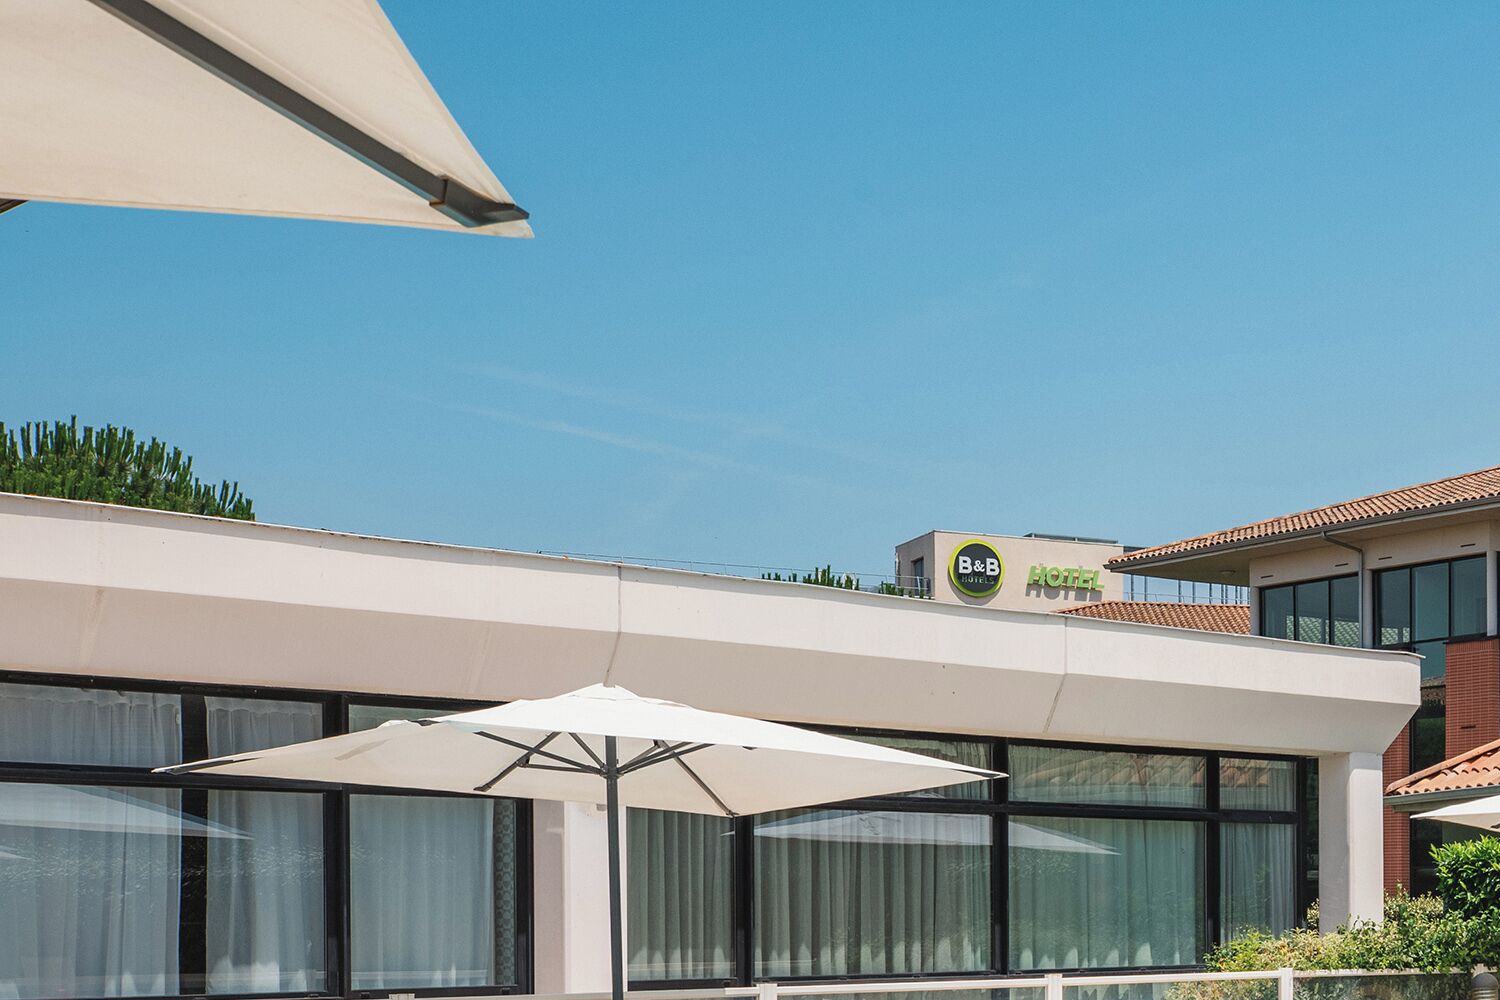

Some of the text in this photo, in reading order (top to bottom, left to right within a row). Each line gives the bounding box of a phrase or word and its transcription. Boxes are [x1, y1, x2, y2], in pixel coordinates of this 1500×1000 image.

[958, 555, 1000, 576] B&B
[961, 575, 995, 585] HOTELS
[1027, 565, 1105, 589] HOTEL
